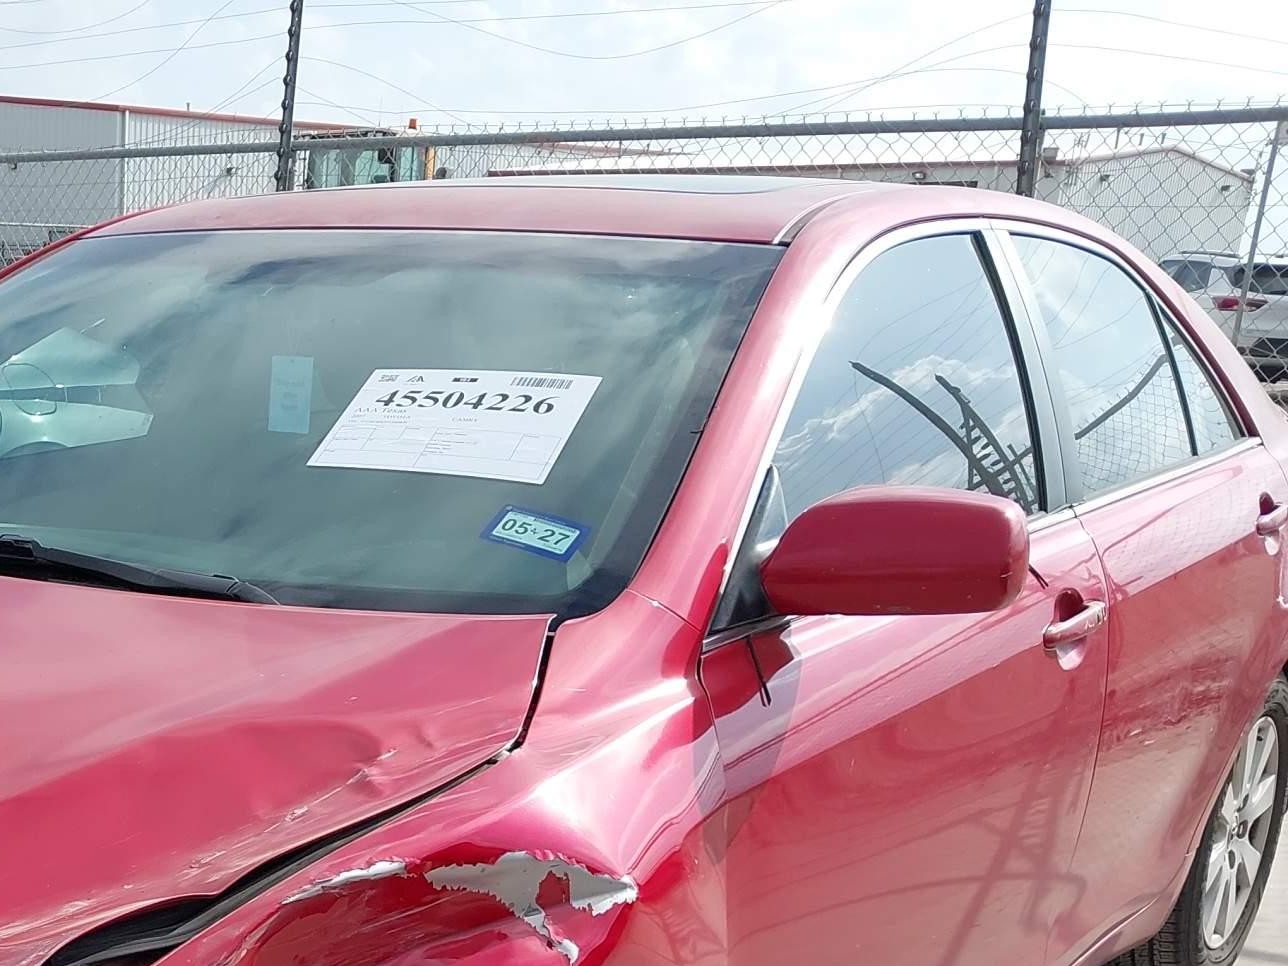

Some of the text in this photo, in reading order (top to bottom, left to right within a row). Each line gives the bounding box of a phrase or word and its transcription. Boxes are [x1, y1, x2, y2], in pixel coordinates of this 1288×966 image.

[375, 390, 561, 415] 45504226
[501, 518, 532, 536] 05
[537, 528, 570, 545] 27
